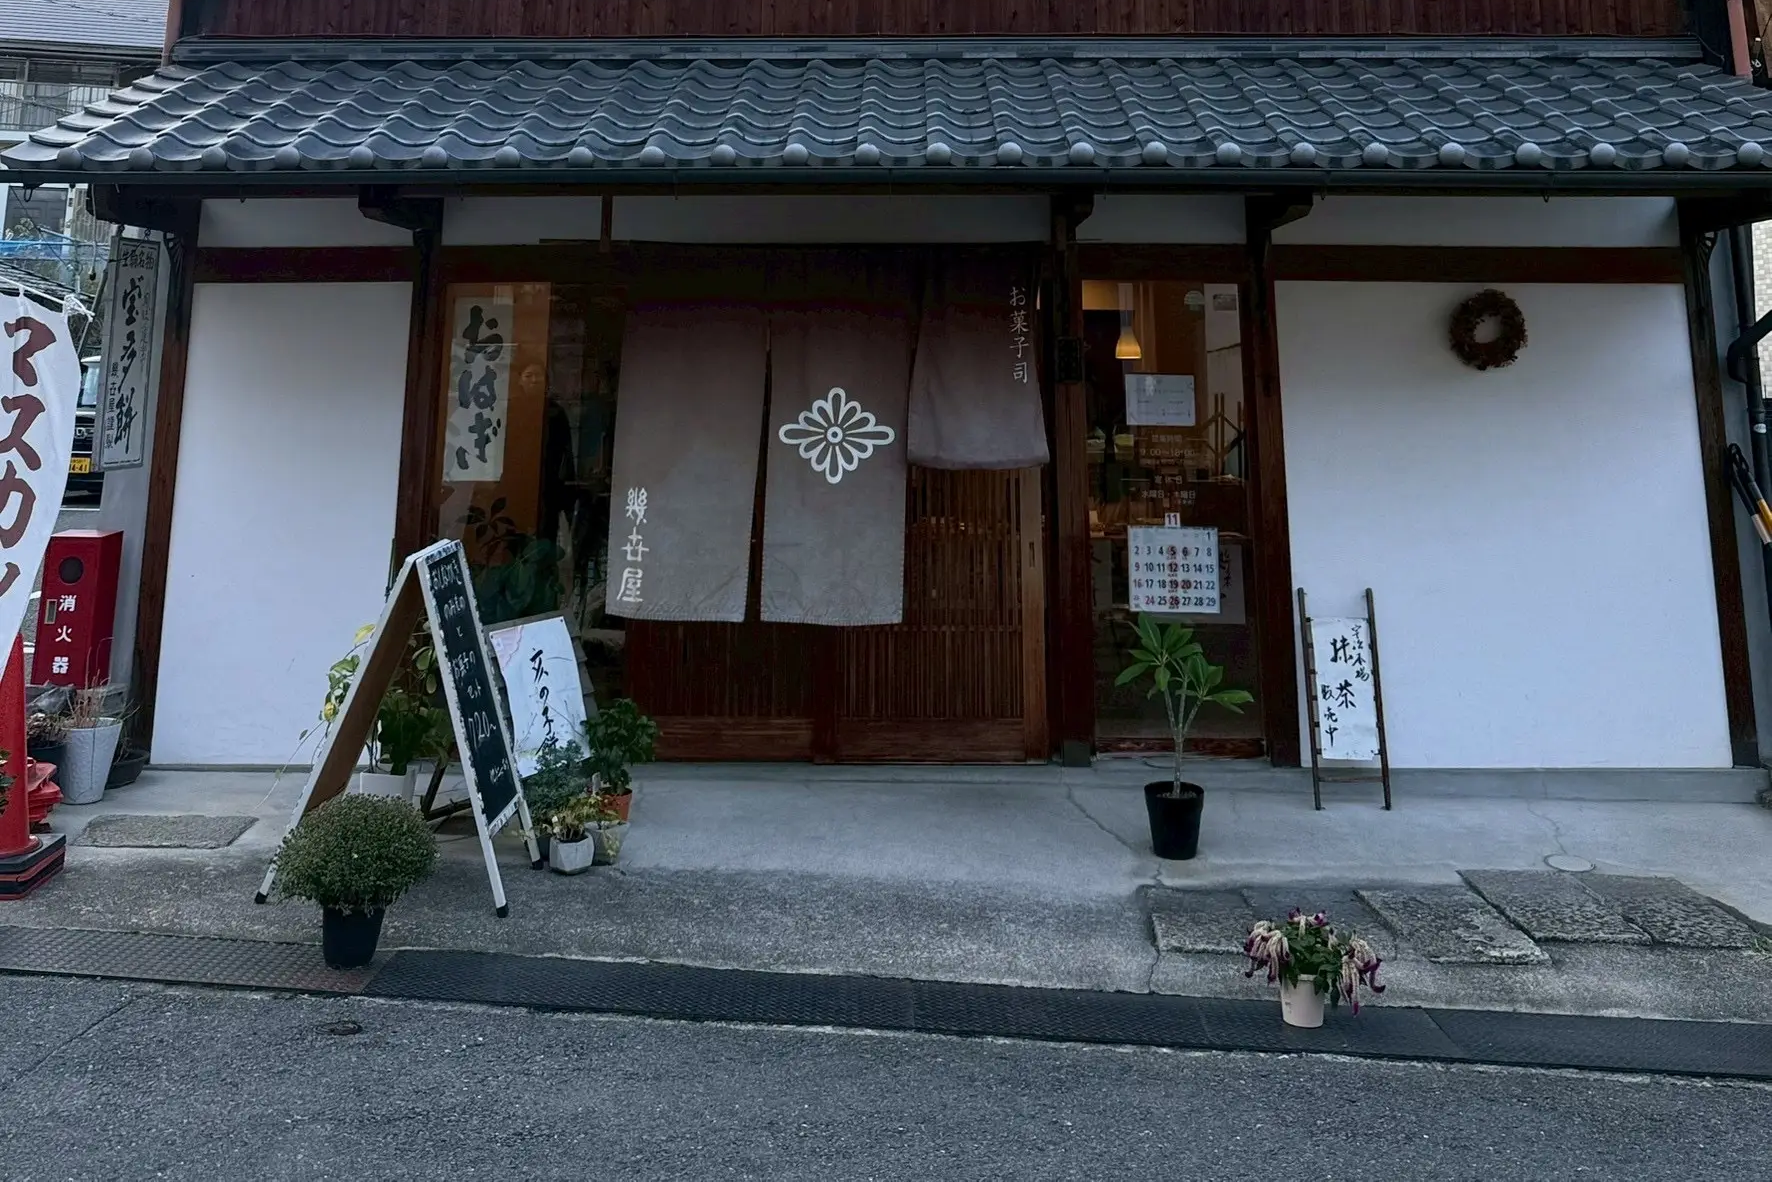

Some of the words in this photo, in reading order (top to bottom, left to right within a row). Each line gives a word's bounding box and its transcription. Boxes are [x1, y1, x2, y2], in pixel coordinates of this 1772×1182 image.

[1009, 286, 1030, 384] お菓子司
[455, 304, 503, 471] おはぎ
[1166, 513, 1178, 526] 11
[1134, 546, 1140, 555] 2
[1146, 546, 1152, 555] 3
[1158, 546, 1164, 556] 4
[1170, 546, 1177, 556] 5
[1194, 547, 1200, 557] 7
[1206, 547, 1212, 557] 8
[1134, 562, 1140, 572] 9
[1144, 562, 1154, 572] 10
[1156, 562, 1165, 573] 11
[1168, 563, 1178, 573] 12
[1181, 563, 1190, 573] 13
[1193, 563, 1202, 573] 14
[1205, 564, 1215, 574] 15
[1145, 579, 1154, 589] 17
[1157, 579, 1167, 589] 18
[1169, 579, 1179, 589] 19
[1181, 580, 1191, 590] 20
[1193, 580, 1203, 590] 21
[1205, 580, 1215, 590] 22
[1145, 596, 1155, 605] 24
[1157, 596, 1167, 606] 25
[1169, 596, 1180, 606] 26
[1182, 597, 1191, 606] 27
[1194, 597, 1204, 606] 28
[1206, 597, 1216, 607] 29
[52, 594, 77, 674] 消火器
[455, 625, 463, 637] と
[1329, 634, 1357, 709] 抹茶
[1320, 682, 1339, 748] 販売中
